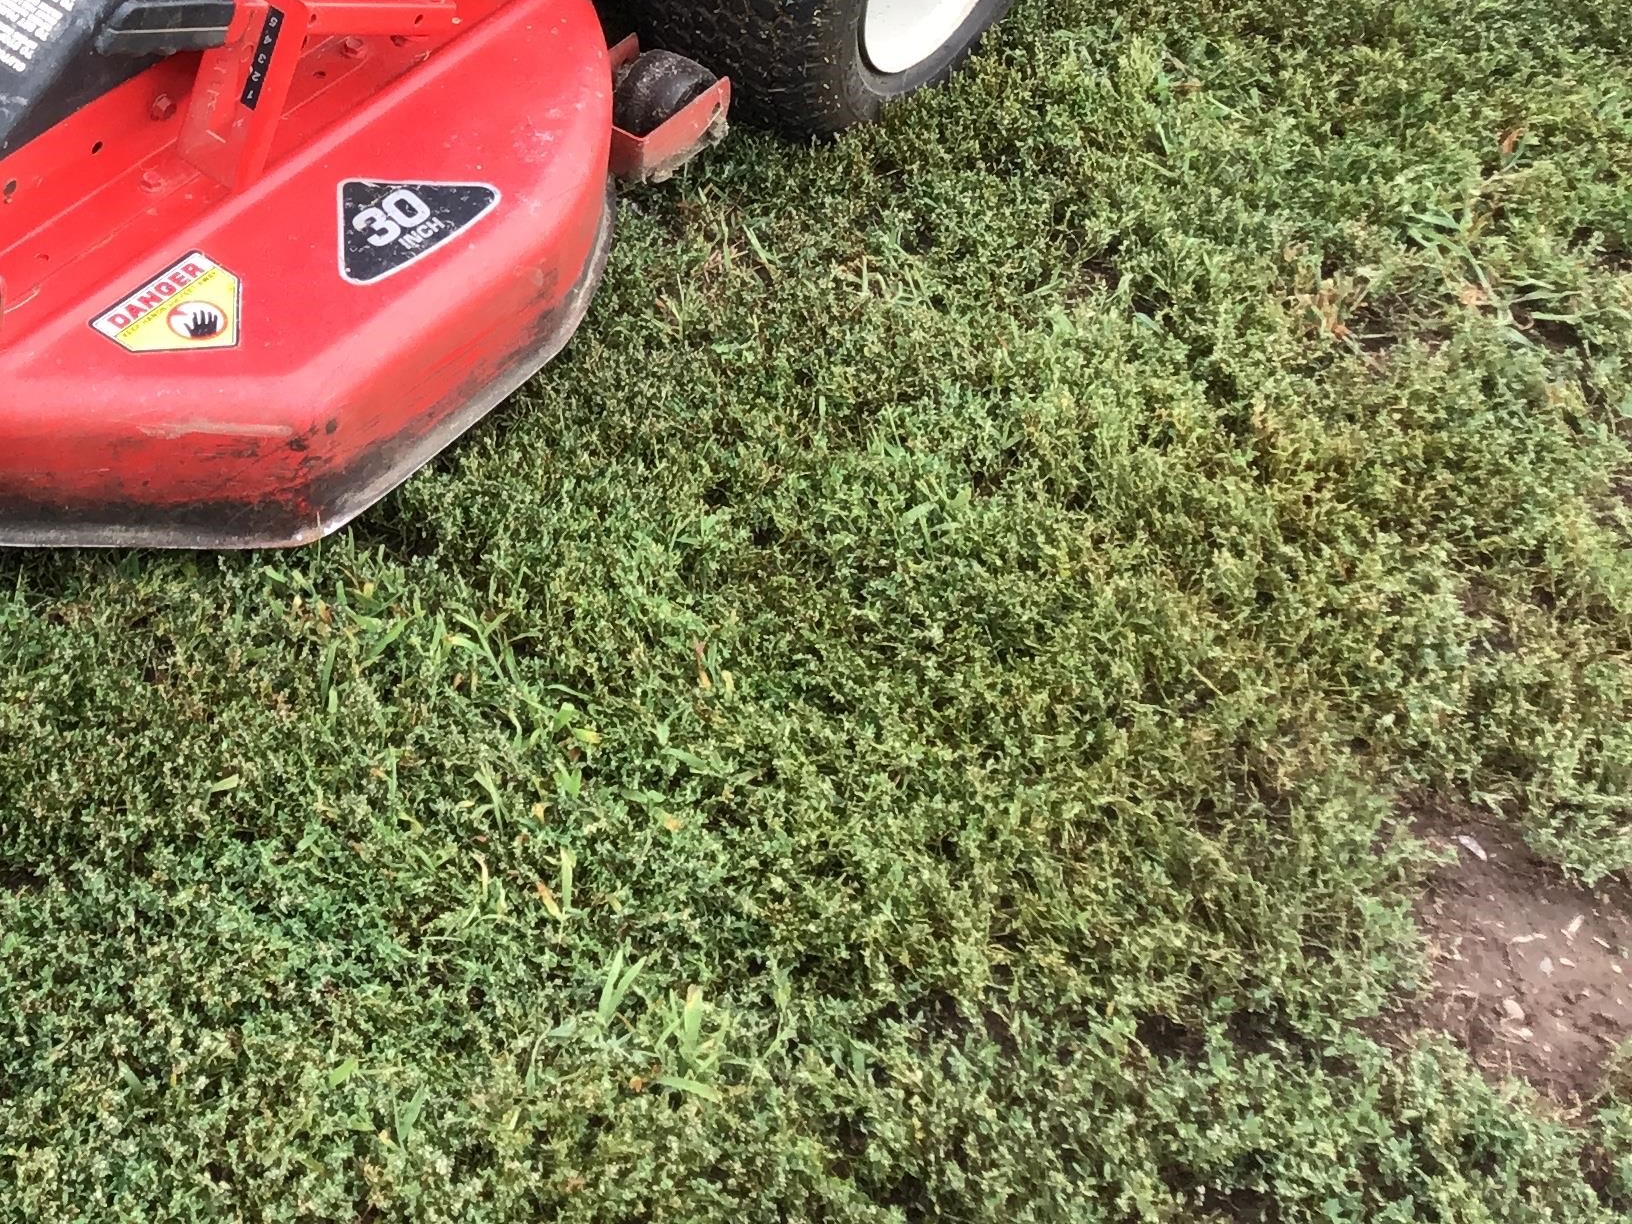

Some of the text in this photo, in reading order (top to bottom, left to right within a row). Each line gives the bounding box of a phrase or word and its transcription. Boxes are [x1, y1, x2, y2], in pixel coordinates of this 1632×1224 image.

[268, 17, 278, 28] 5
[263, 35, 272, 45] 4
[257, 53, 266, 64] 3
[251, 71, 261, 81] 2
[246, 90, 254, 99] 1
[352, 189, 431, 247] 30
[398, 216, 446, 250] INCH
[108, 263, 206, 329] DANGER
